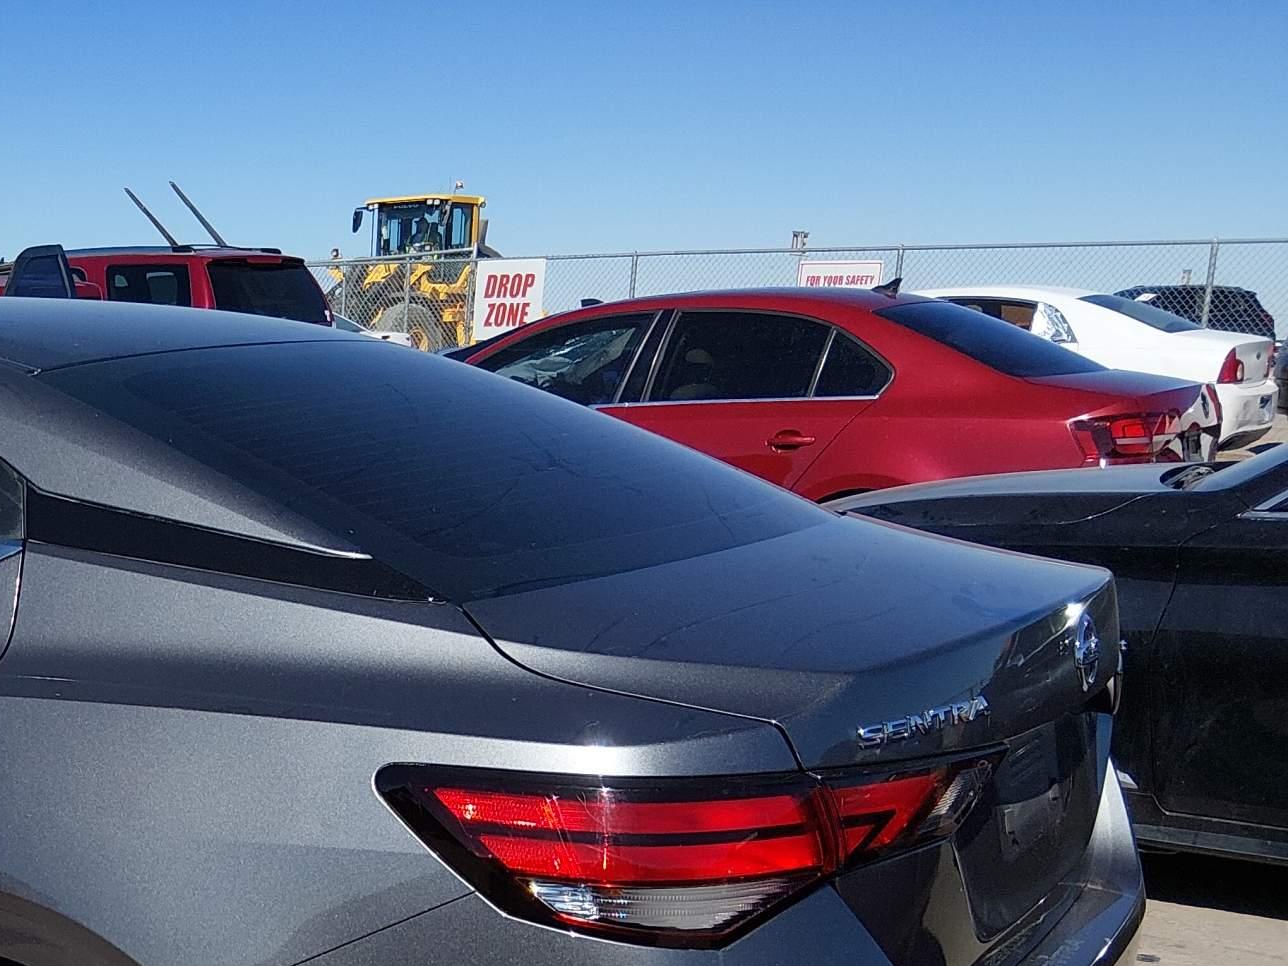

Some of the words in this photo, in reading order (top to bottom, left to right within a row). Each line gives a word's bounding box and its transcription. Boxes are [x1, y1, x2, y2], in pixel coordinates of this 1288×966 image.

[483, 272, 536, 299] DROP
[806, 275, 821, 287] FOR
[823, 275, 844, 287] YOUR
[845, 274, 875, 286] SAFETY
[483, 302, 531, 327] ZONE
[856, 695, 990, 742] SENTRA
